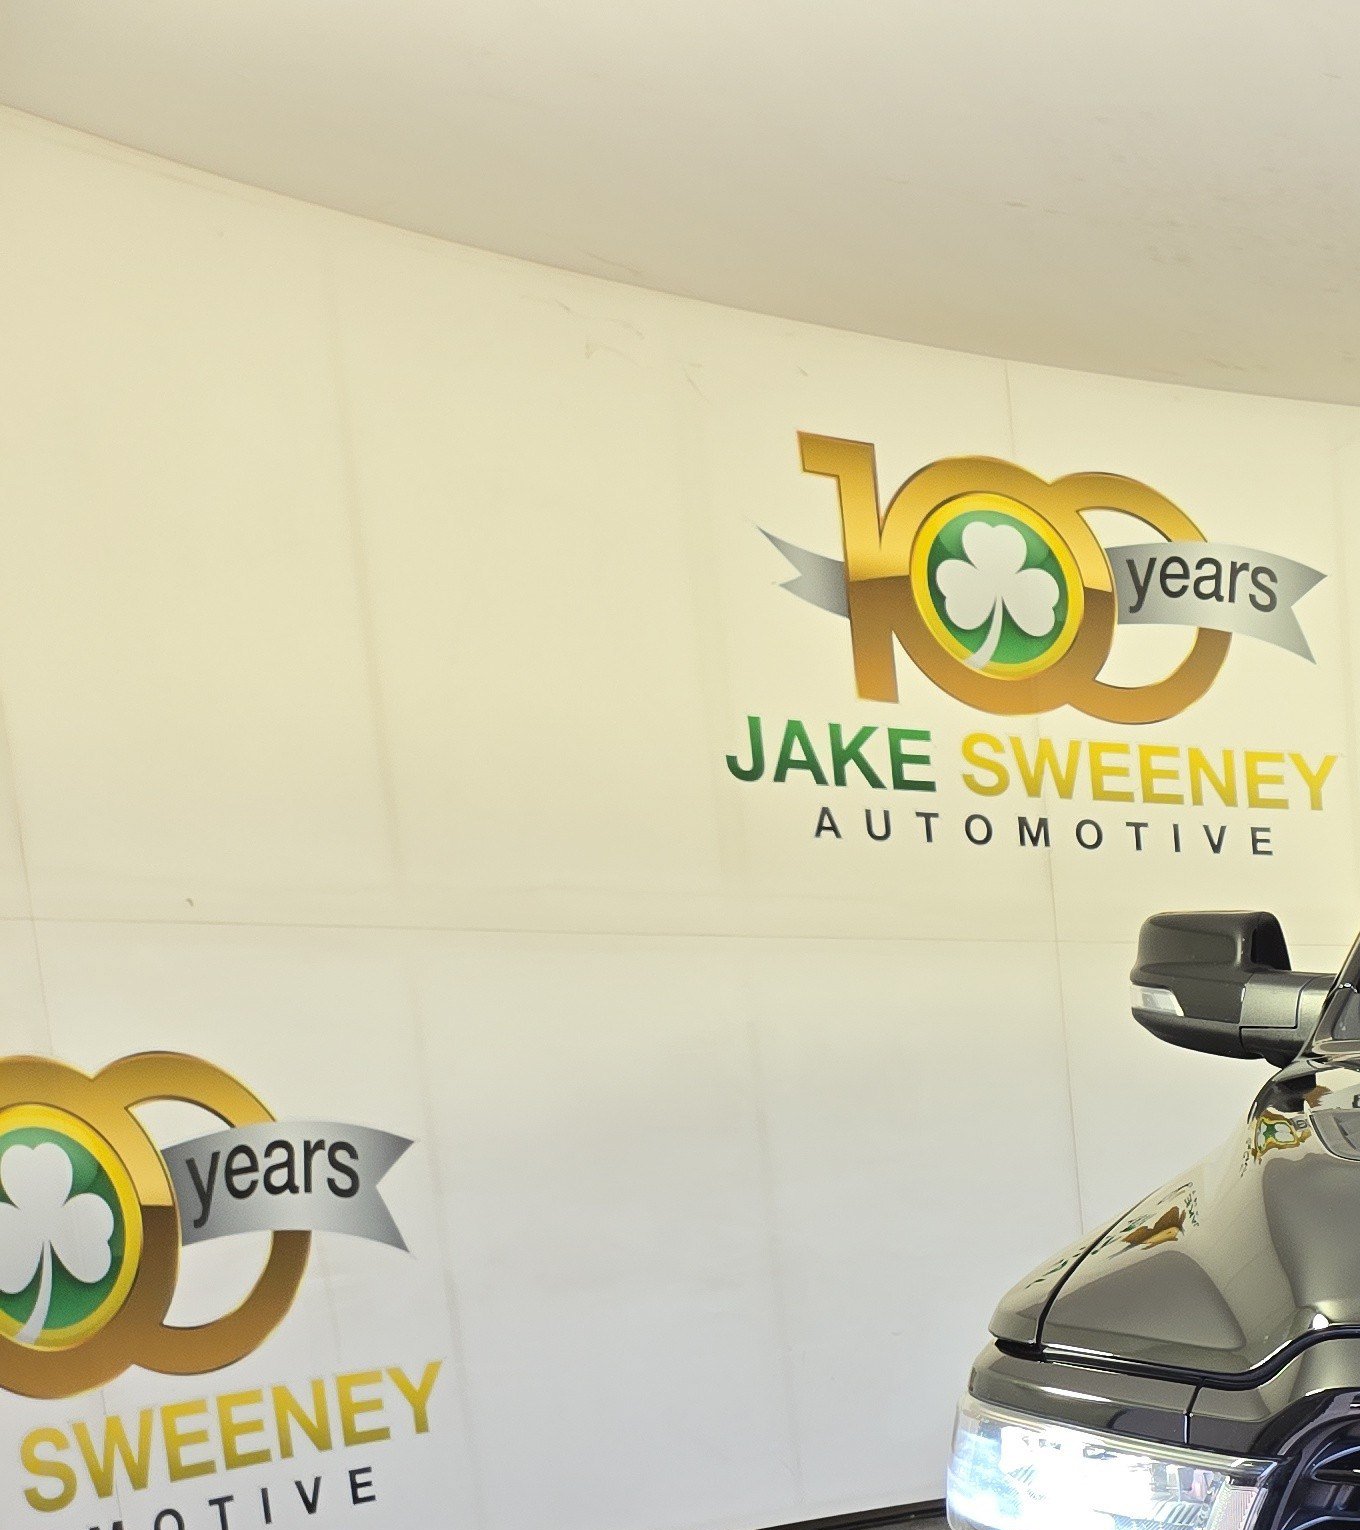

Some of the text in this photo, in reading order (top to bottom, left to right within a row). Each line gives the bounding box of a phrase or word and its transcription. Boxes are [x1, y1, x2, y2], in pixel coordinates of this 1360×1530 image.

[797, 431, 1279, 725] 100 years
[725, 715, 1339, 810] JAKE SWEENEY
[813, 805, 1274, 856] AUTOMOTIVE
[186, 1138, 360, 1228] years
[19, 1361, 443, 1513] SWEENEY
